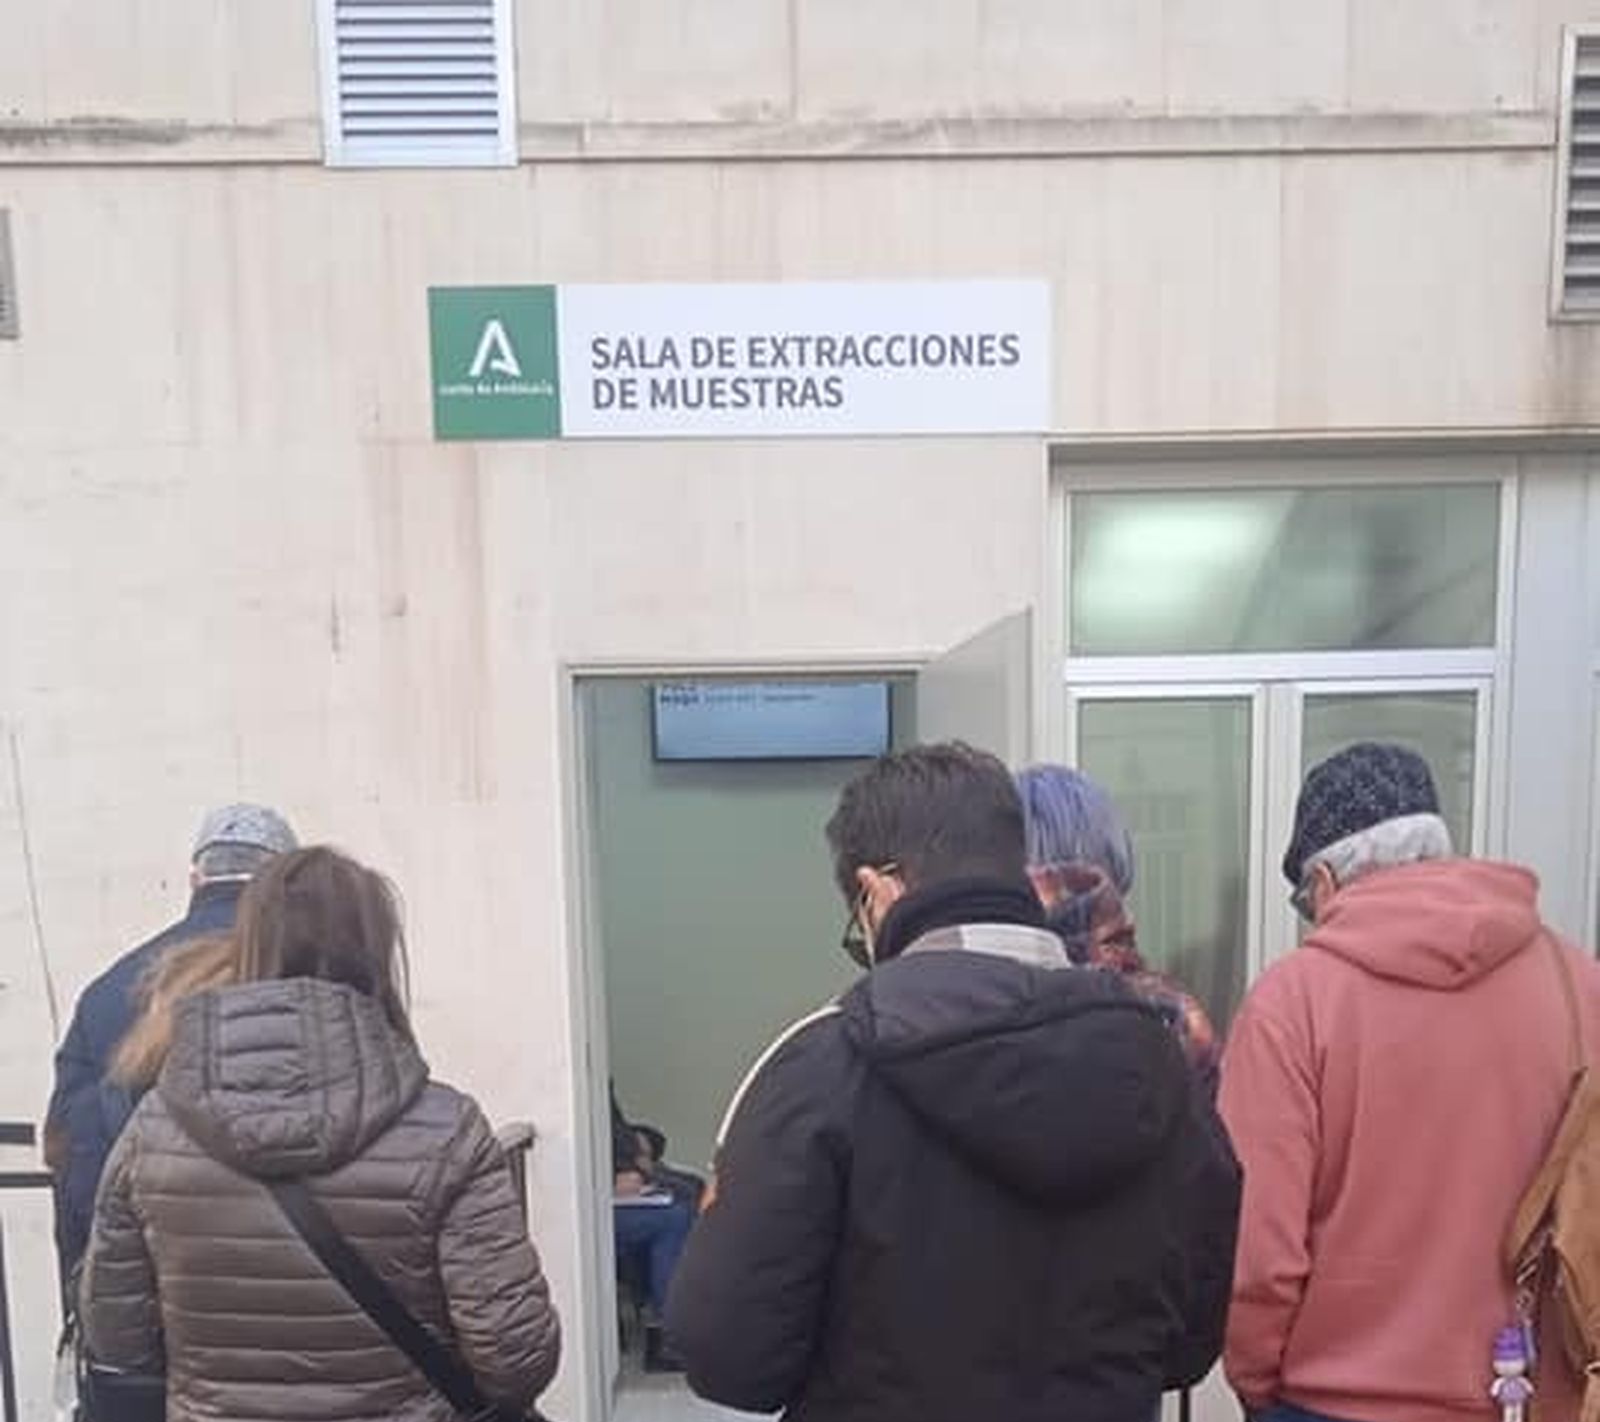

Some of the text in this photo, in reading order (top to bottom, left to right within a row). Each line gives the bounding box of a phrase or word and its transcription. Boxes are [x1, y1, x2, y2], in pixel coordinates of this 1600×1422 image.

[591, 333, 1020, 370] SALA DE EXTRACCIONES
[592, 378, 638, 410] DE
[649, 375, 845, 409] MUESTRAS
